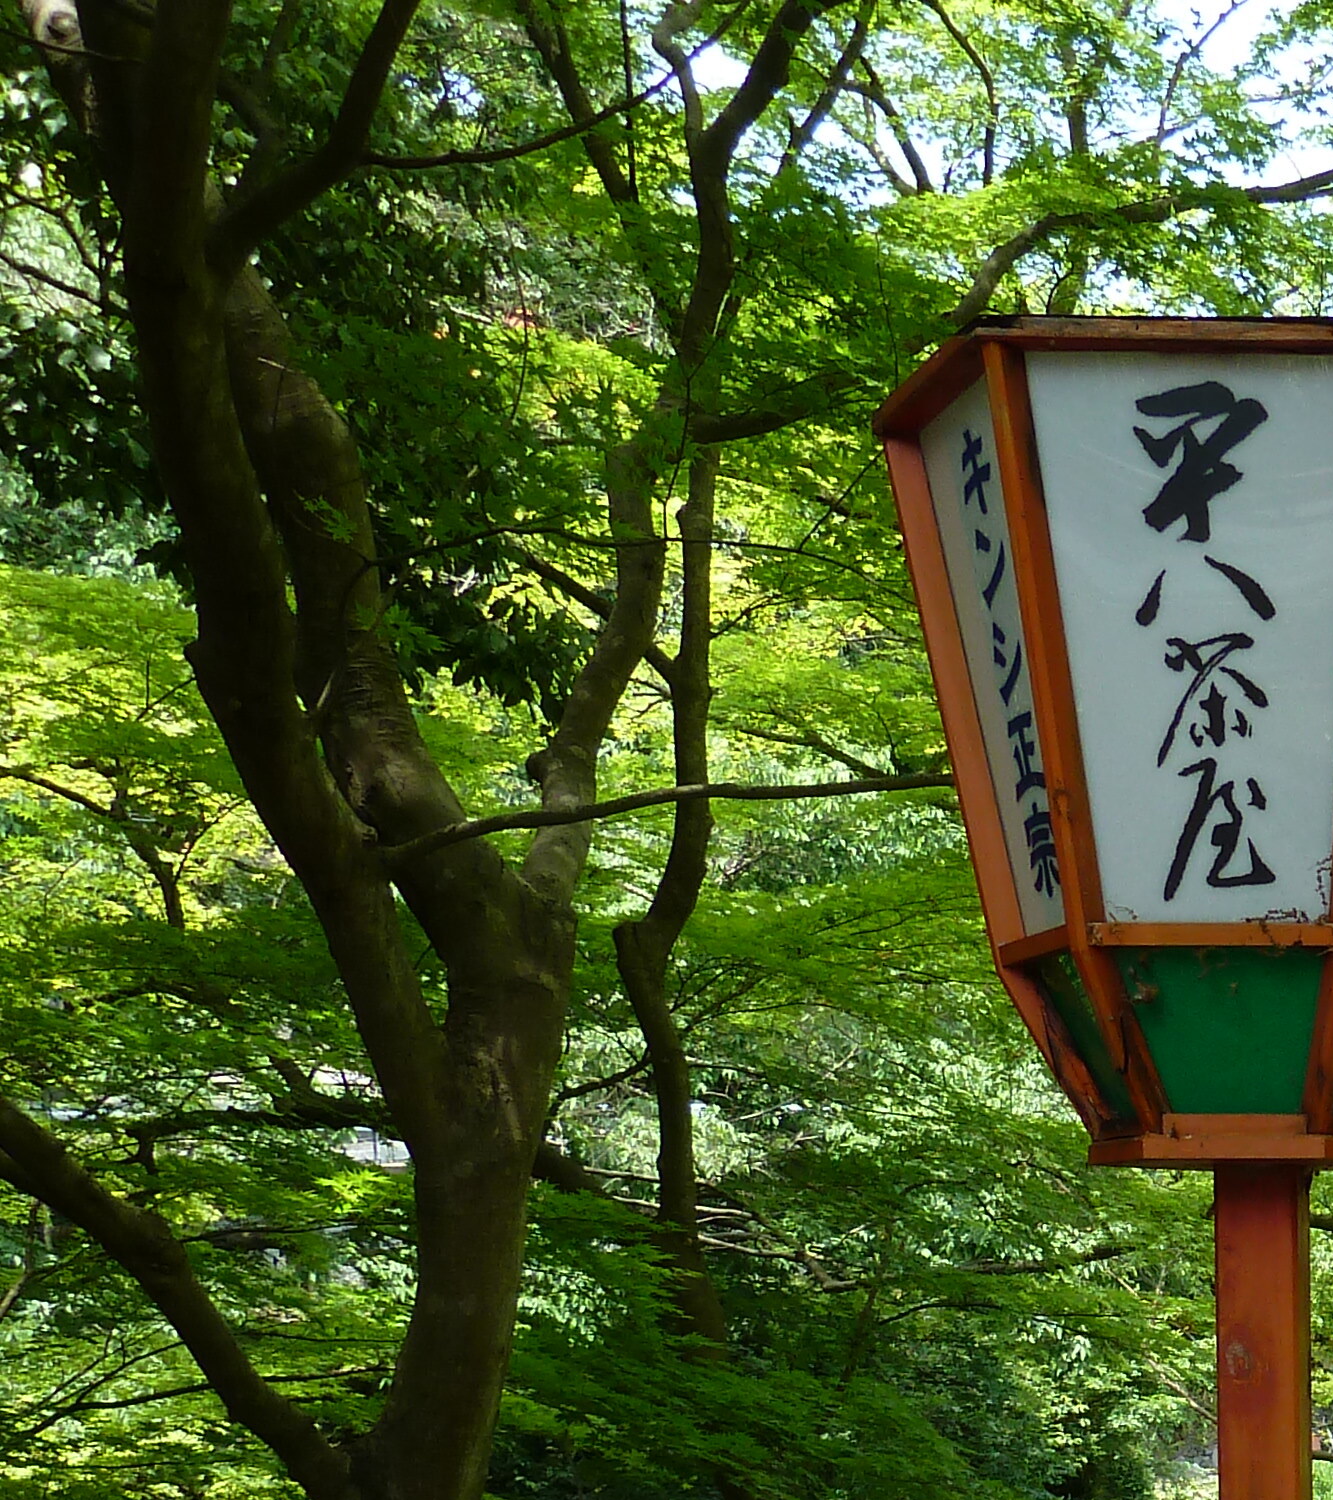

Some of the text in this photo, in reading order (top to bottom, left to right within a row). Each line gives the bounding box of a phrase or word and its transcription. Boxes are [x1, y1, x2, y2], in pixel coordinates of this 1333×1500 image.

[962, 428, 1061, 898] キンシ正宗
[1133, 381, 1275, 901] 平八茶屋
